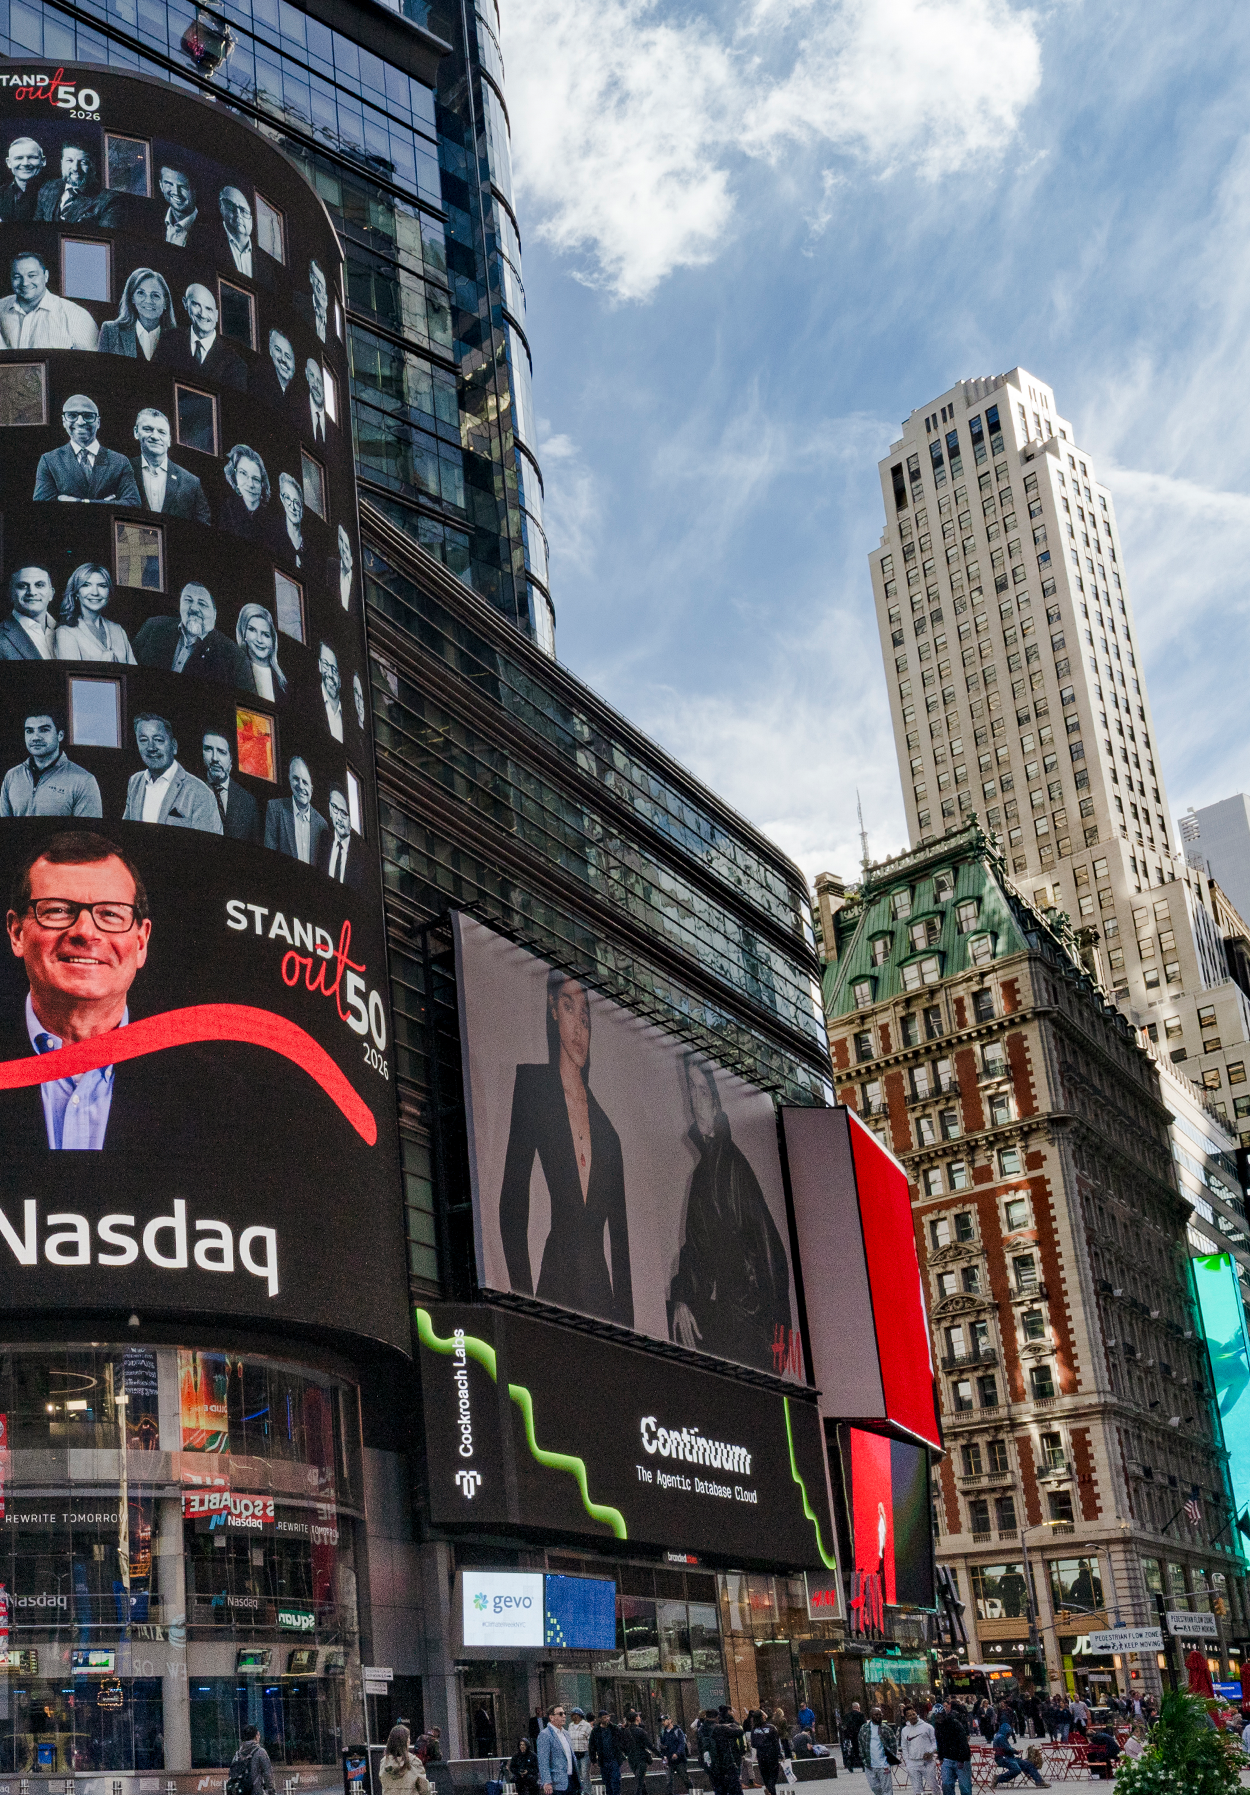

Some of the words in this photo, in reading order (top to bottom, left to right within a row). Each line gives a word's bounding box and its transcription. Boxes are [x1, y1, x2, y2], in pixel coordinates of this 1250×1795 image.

[15, 67, 76, 106] out
[56, 85, 100, 111] 50
[70, 109, 101, 121] 2026
[226, 900, 334, 959] STAND
[281, 919, 366, 1022] out
[346, 969, 387, 1052] 50
[363, 1042, 389, 1081] 2026
[453, 1328, 466, 1367] Labs
[454, 1369, 473, 1458] Cockroach
[640, 1416, 752, 1475] Continuum
[636, 1465, 653, 1483] The
[656, 1469, 692, 1490] Agentic
[694, 1477, 732, 1499] Database
[734, 1486, 758, 1504] Cloud
[6, 1514, 56, 1523] REWRITE
[61, 1514, 128, 1523] TOMORROW
[227, 1515, 263, 1530] Nasdaq
[278, 1522, 309, 1533] REWRITE
[227, 1597, 258, 1609] Nasdaq
[493, 1595, 532, 1614] gevo
[811, 1589, 836, 1608] H&M
[1170, 1615, 1193, 1623] PEDESTRIAN
[1095, 1633, 1128, 1642] PEDESTRIAN
[1128, 1632, 1143, 1640] FLOW
[1144, 1631, 1159, 1639] ZONE
